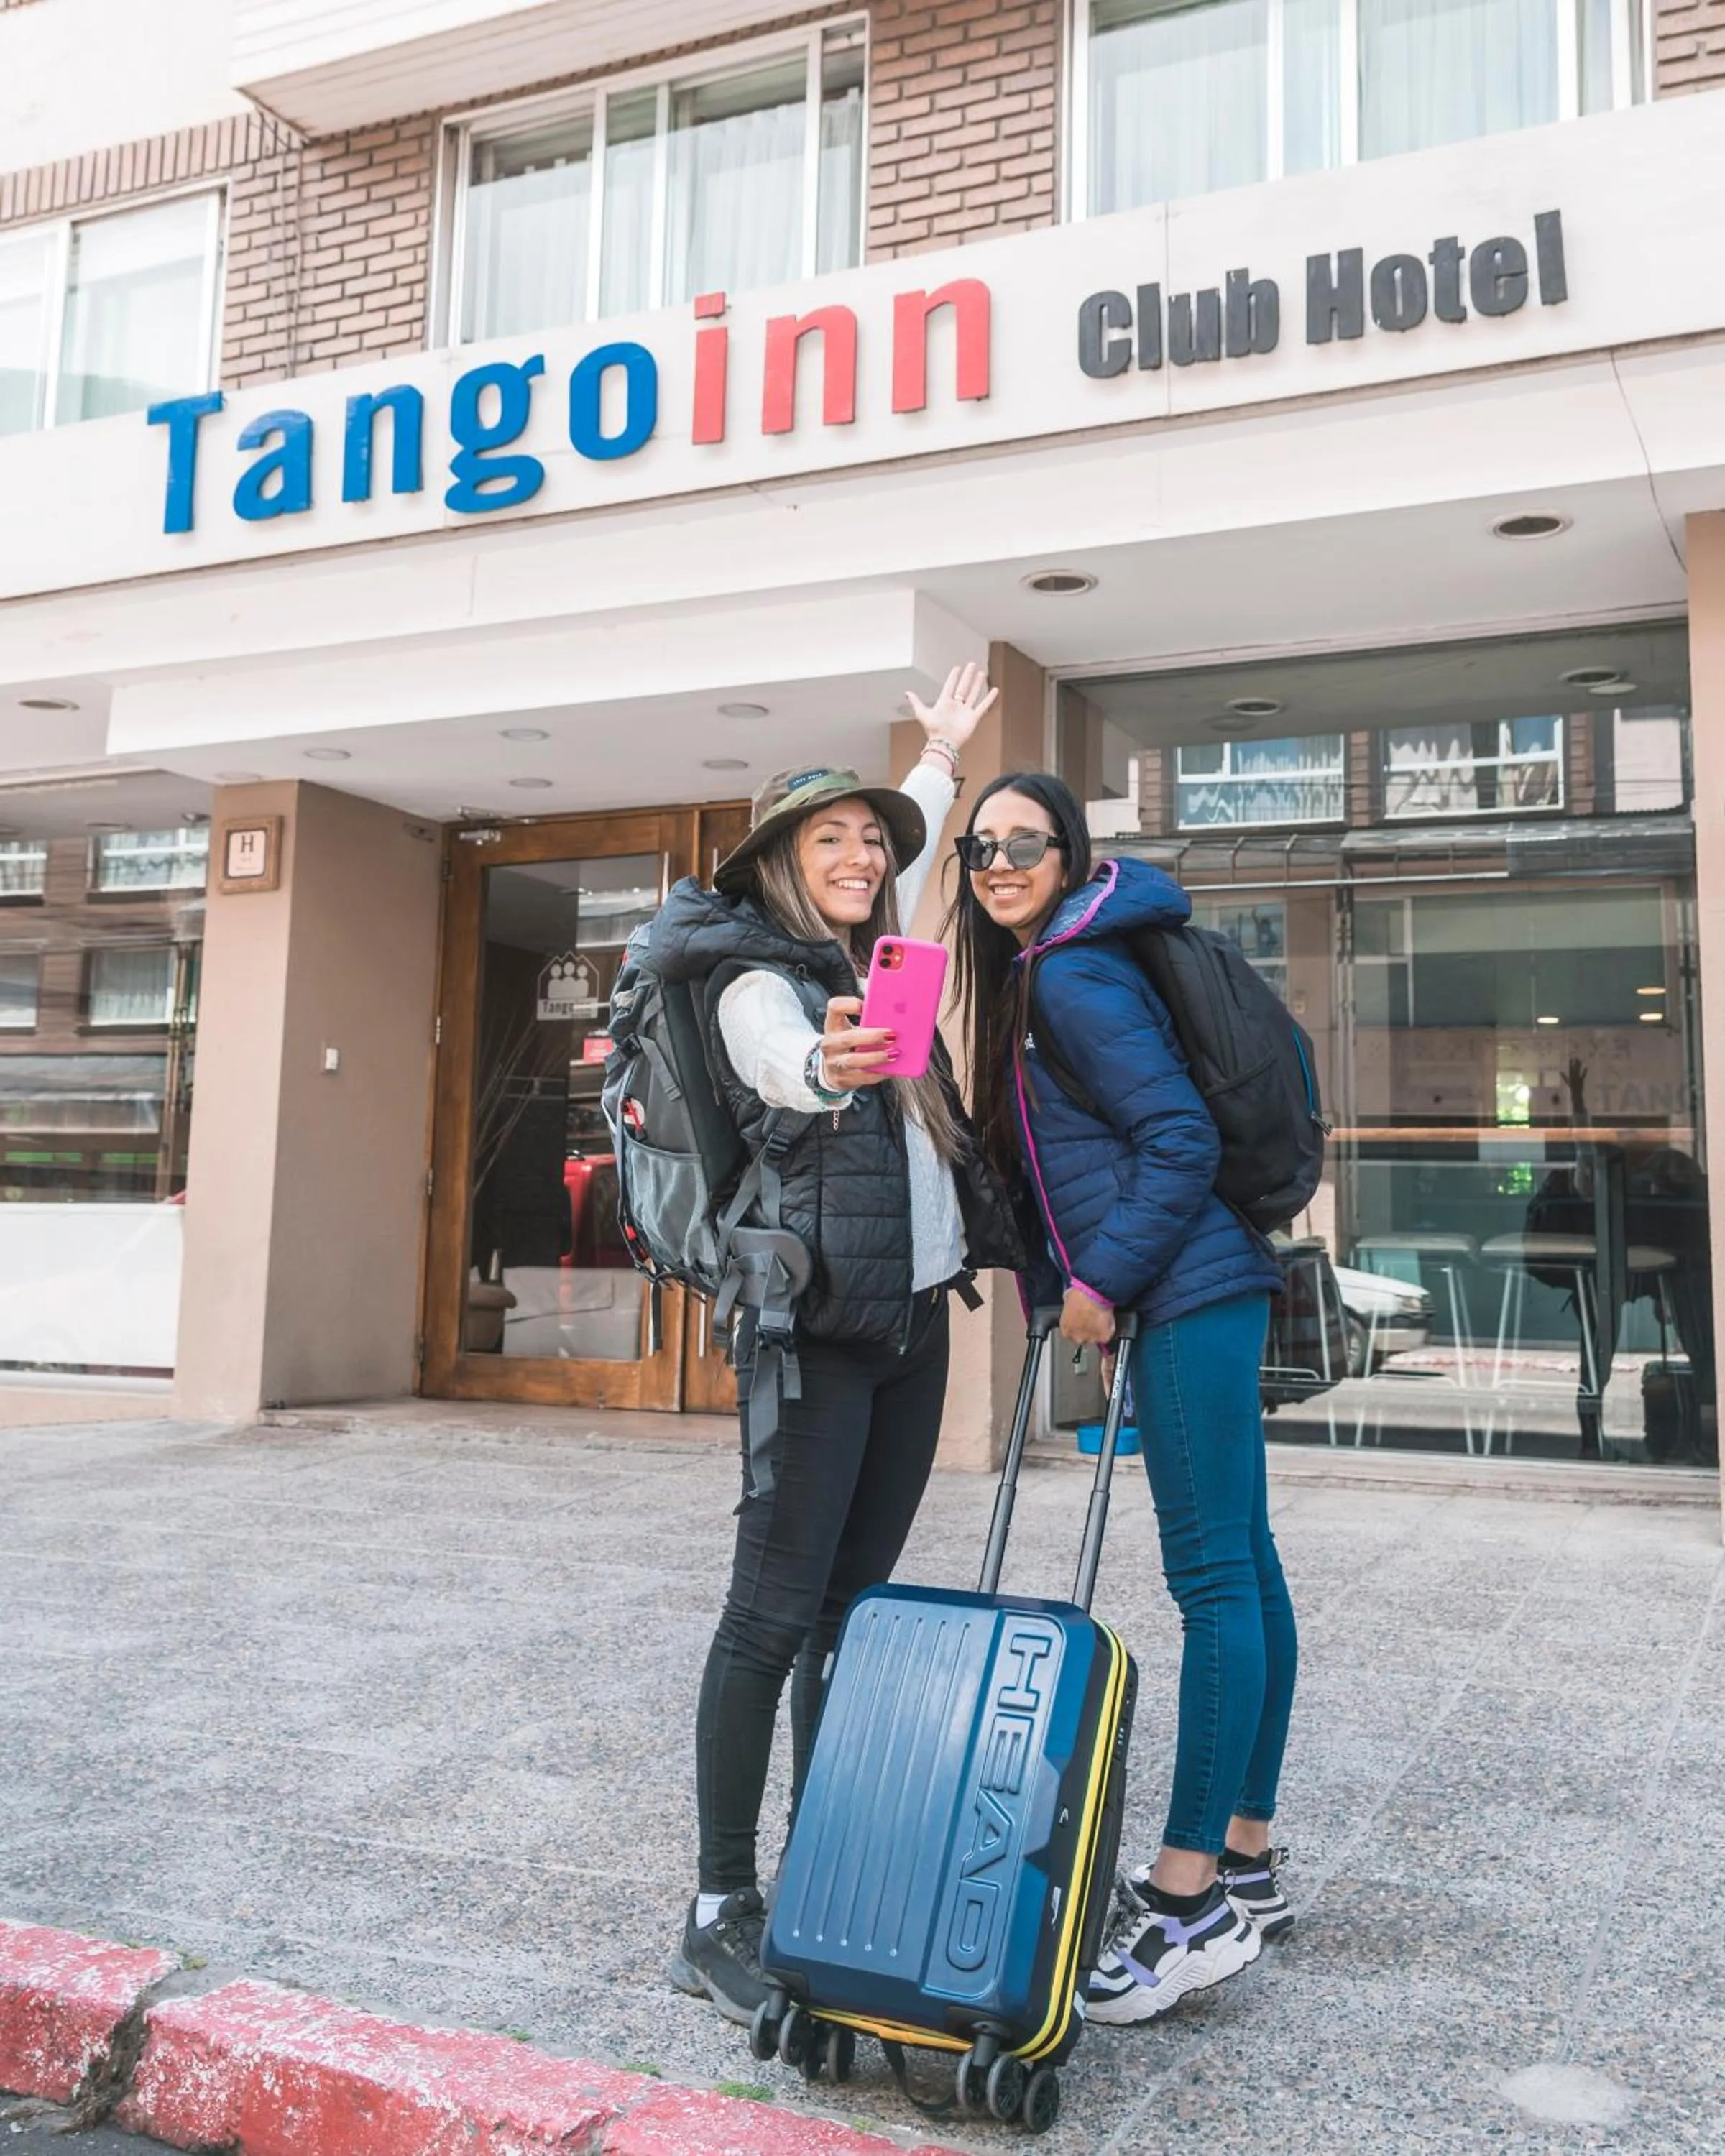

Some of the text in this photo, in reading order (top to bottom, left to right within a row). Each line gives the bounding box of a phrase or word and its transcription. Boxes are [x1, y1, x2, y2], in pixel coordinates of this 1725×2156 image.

[1077, 209, 1568, 379] Club Hotel
[241, 834, 254, 853] H
[946, 1634, 1052, 1971] HEAD
